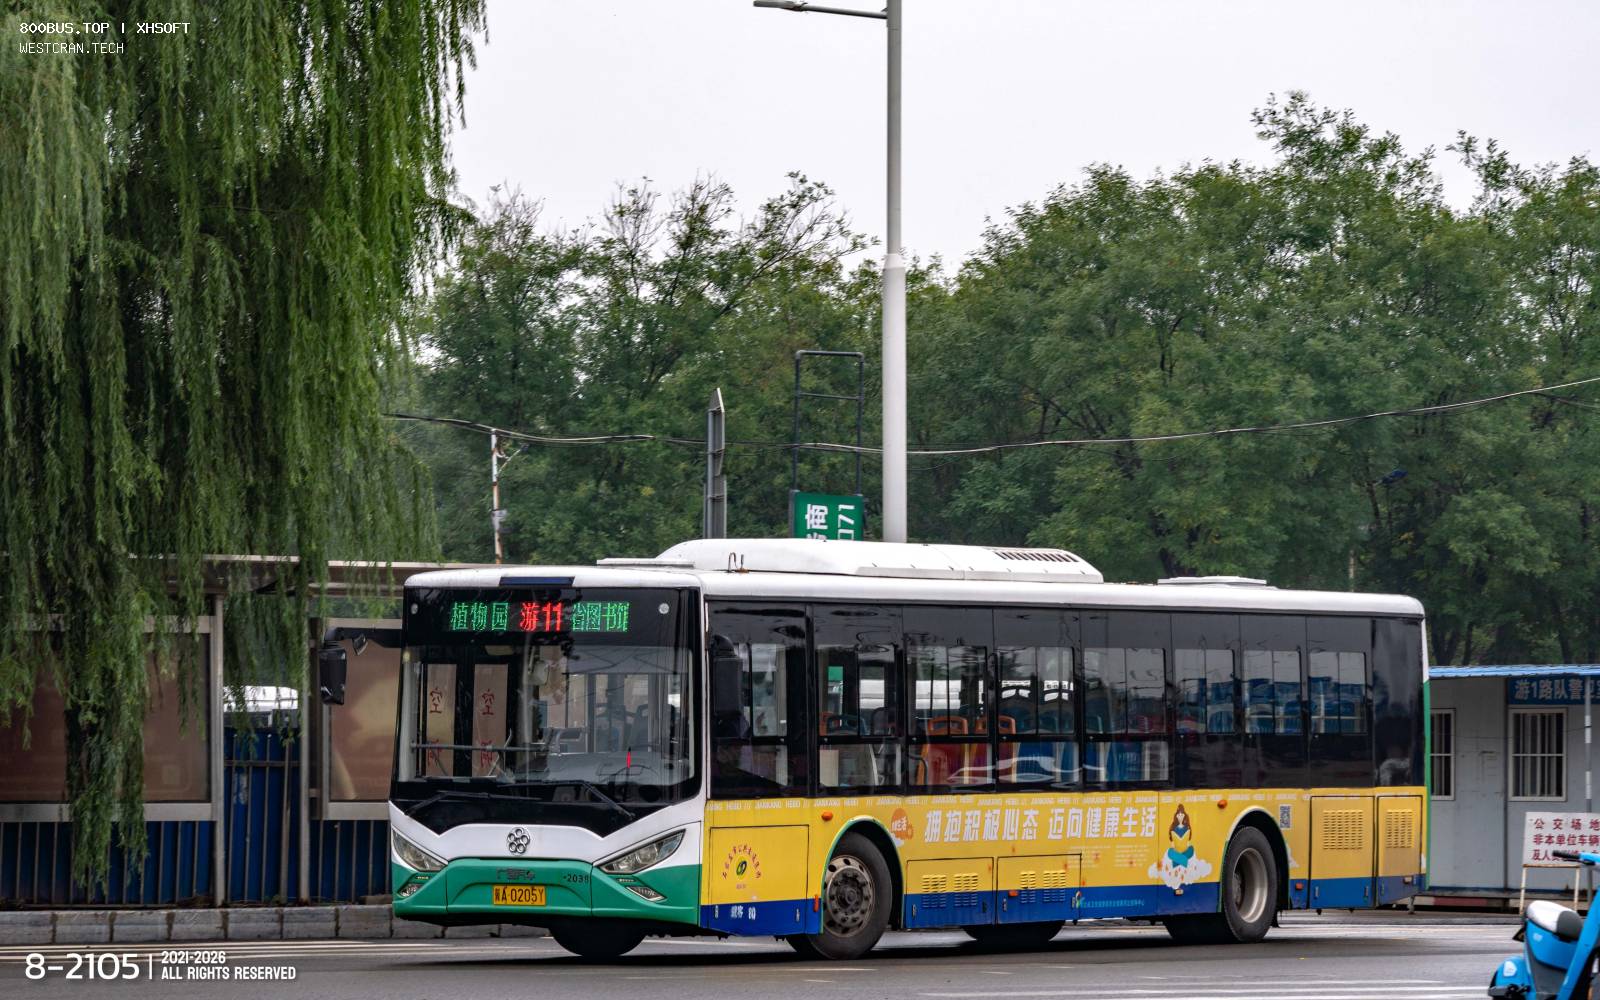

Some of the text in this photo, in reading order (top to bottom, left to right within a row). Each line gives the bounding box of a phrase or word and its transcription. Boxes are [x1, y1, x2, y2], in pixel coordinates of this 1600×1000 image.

[450, 601, 509, 631] 植物园
[519, 602, 564, 632] 游11
[923, 805, 1158, 843] 拥抱积极心态 迈向健康生活
